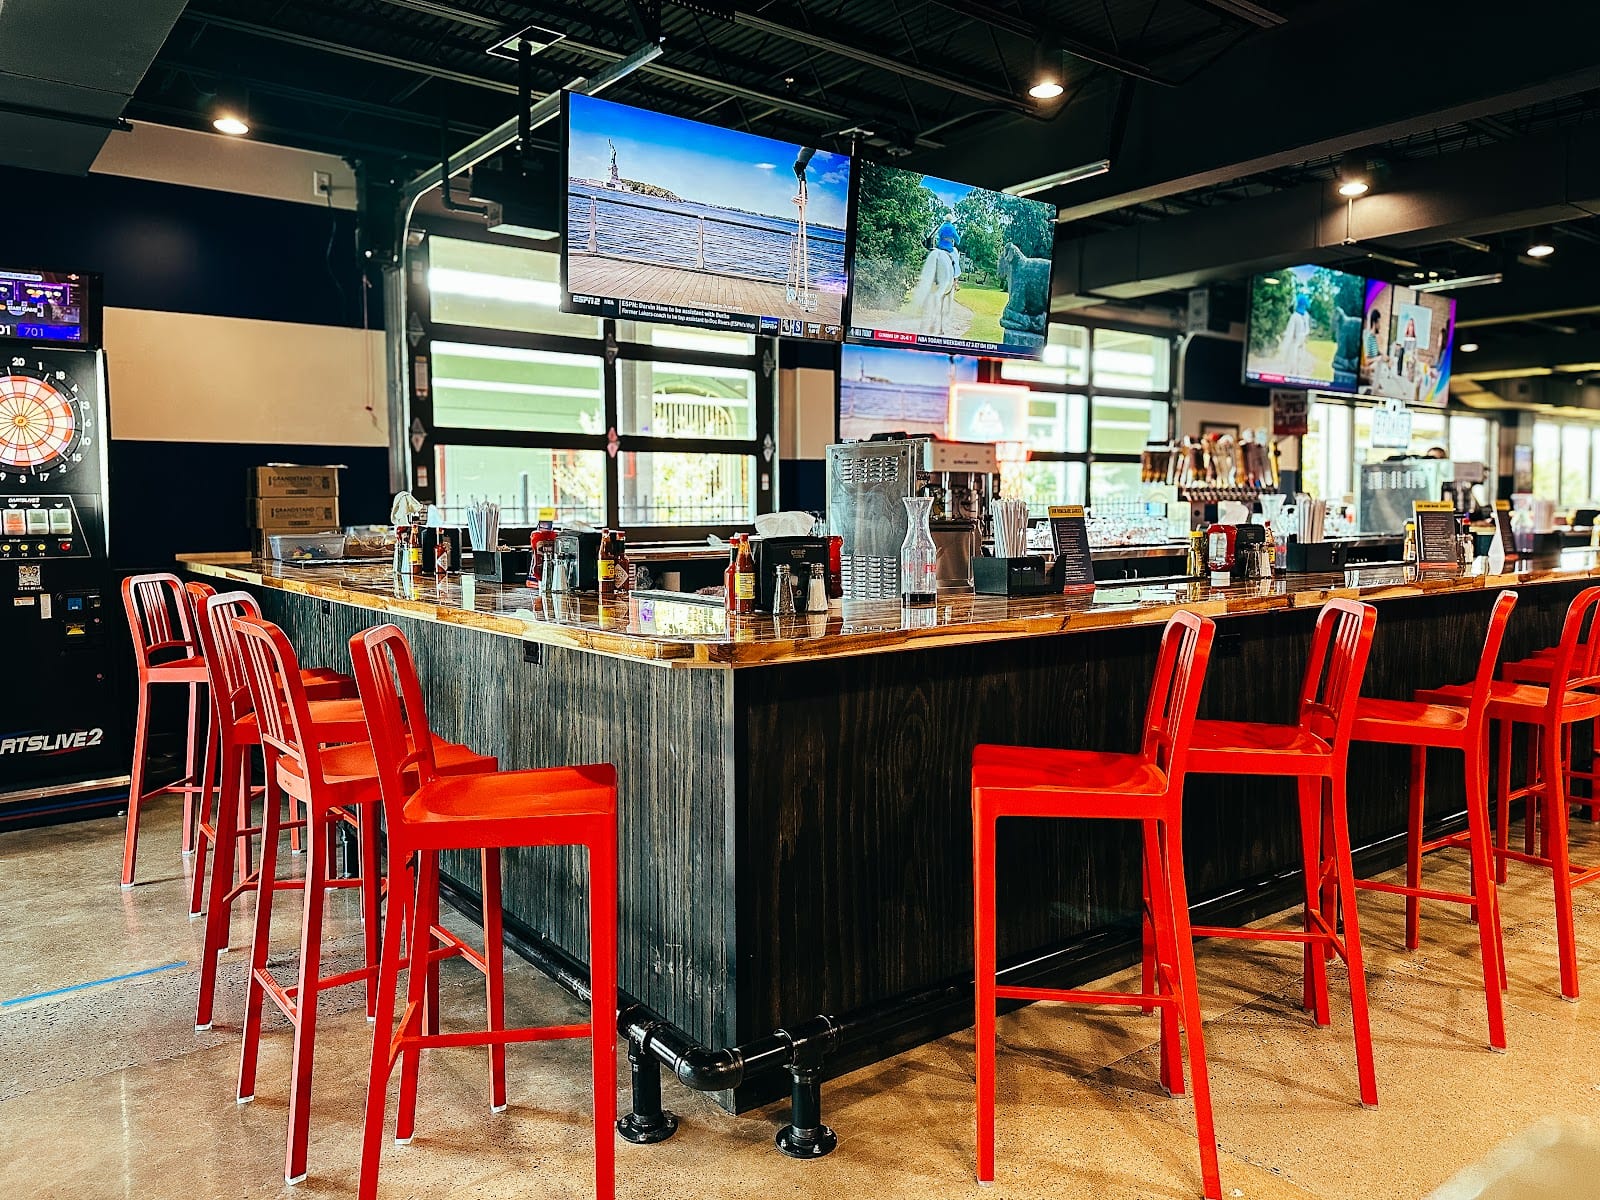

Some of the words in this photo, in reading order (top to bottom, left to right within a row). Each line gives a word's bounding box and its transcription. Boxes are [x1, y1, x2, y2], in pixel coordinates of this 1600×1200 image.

[24, 327, 44, 336] 701
[12, 357, 25, 366] 20
[38, 362, 43, 370] 1
[56, 371, 66, 380] 18
[71, 383, 78, 393] 4
[80, 401, 90, 410] 13
[85, 420, 92, 428] 6
[81, 438, 91, 446] 10
[72, 453, 82, 462] 15
[59, 464, 67, 473] 2
[19, 475, 26, 484] 3
[39, 473, 50, 482] 17
